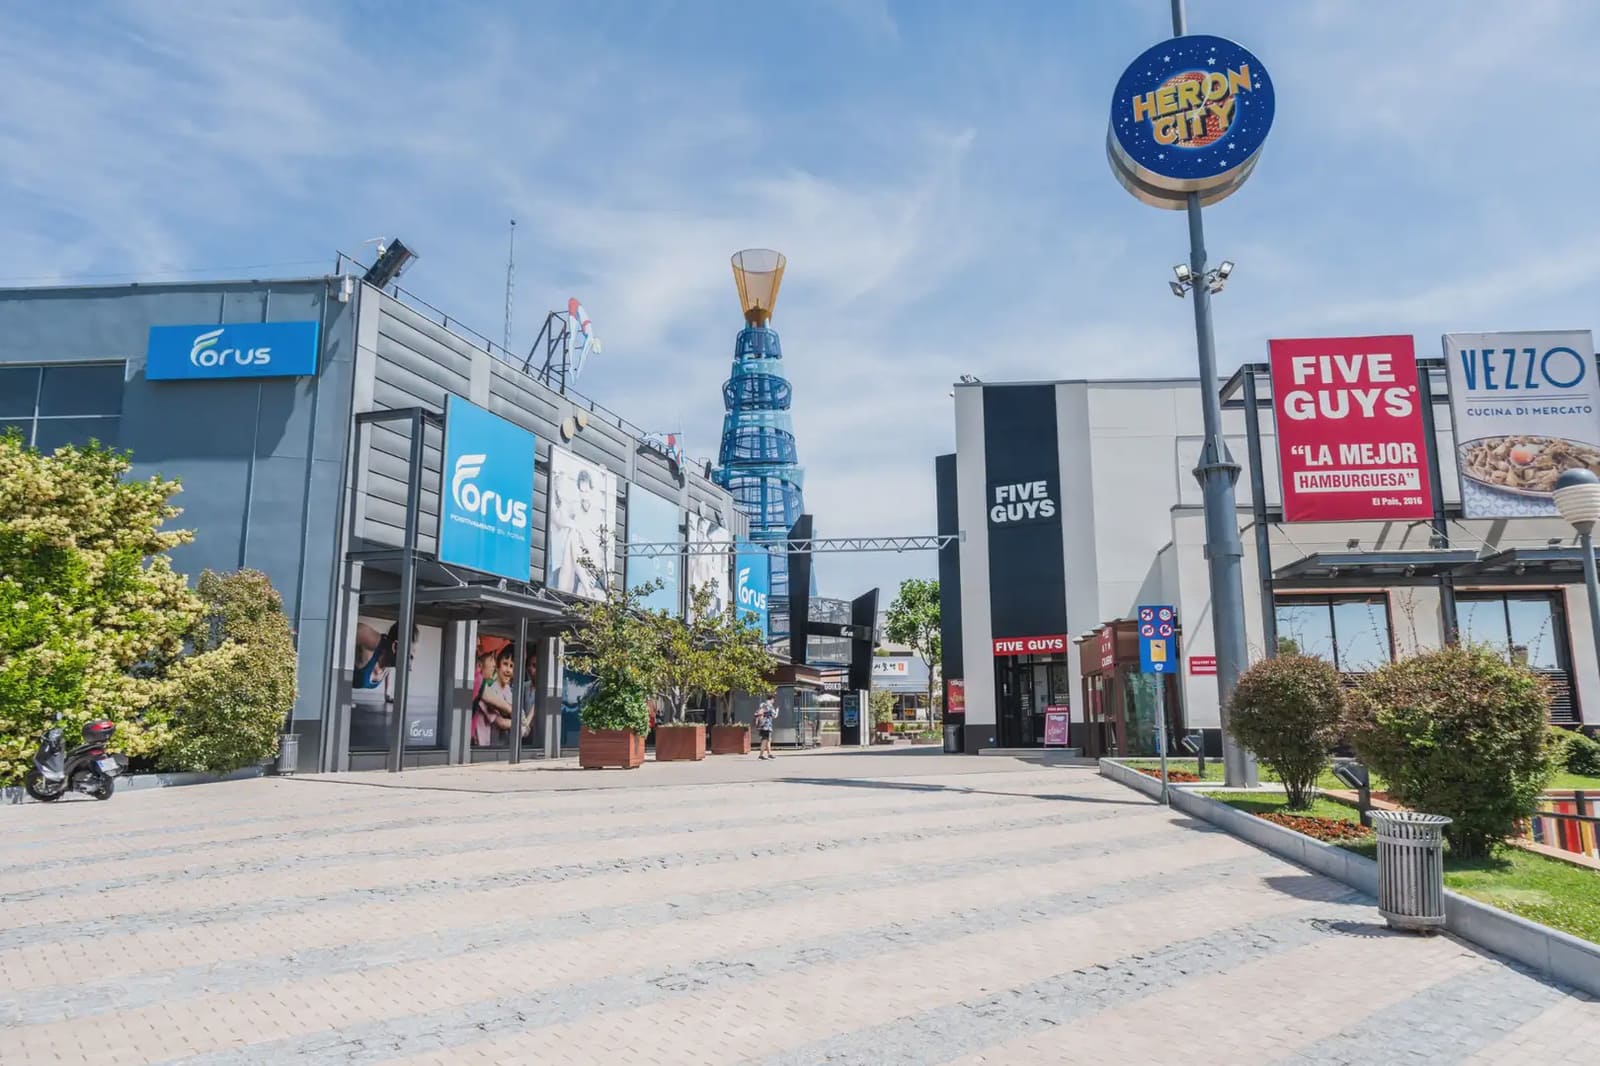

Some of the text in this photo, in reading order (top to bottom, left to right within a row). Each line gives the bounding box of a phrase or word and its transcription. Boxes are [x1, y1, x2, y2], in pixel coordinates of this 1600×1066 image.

[1132, 64, 1252, 123] HERON
[1153, 98, 1236, 145] CITY
[1291, 353, 1396, 385] FIVE
[1460, 347, 1586, 390] VEZZO
[1467, 405, 1592, 416] CUCINA DI MERCATO
[1339, 442, 1418, 465] MEJOR
[995, 480, 1048, 504] FIVE
[1403, 496, 1422, 505] 2016
[991, 499, 1055, 523] GUYS
[995, 639, 1063, 653] FIVE GUYS
